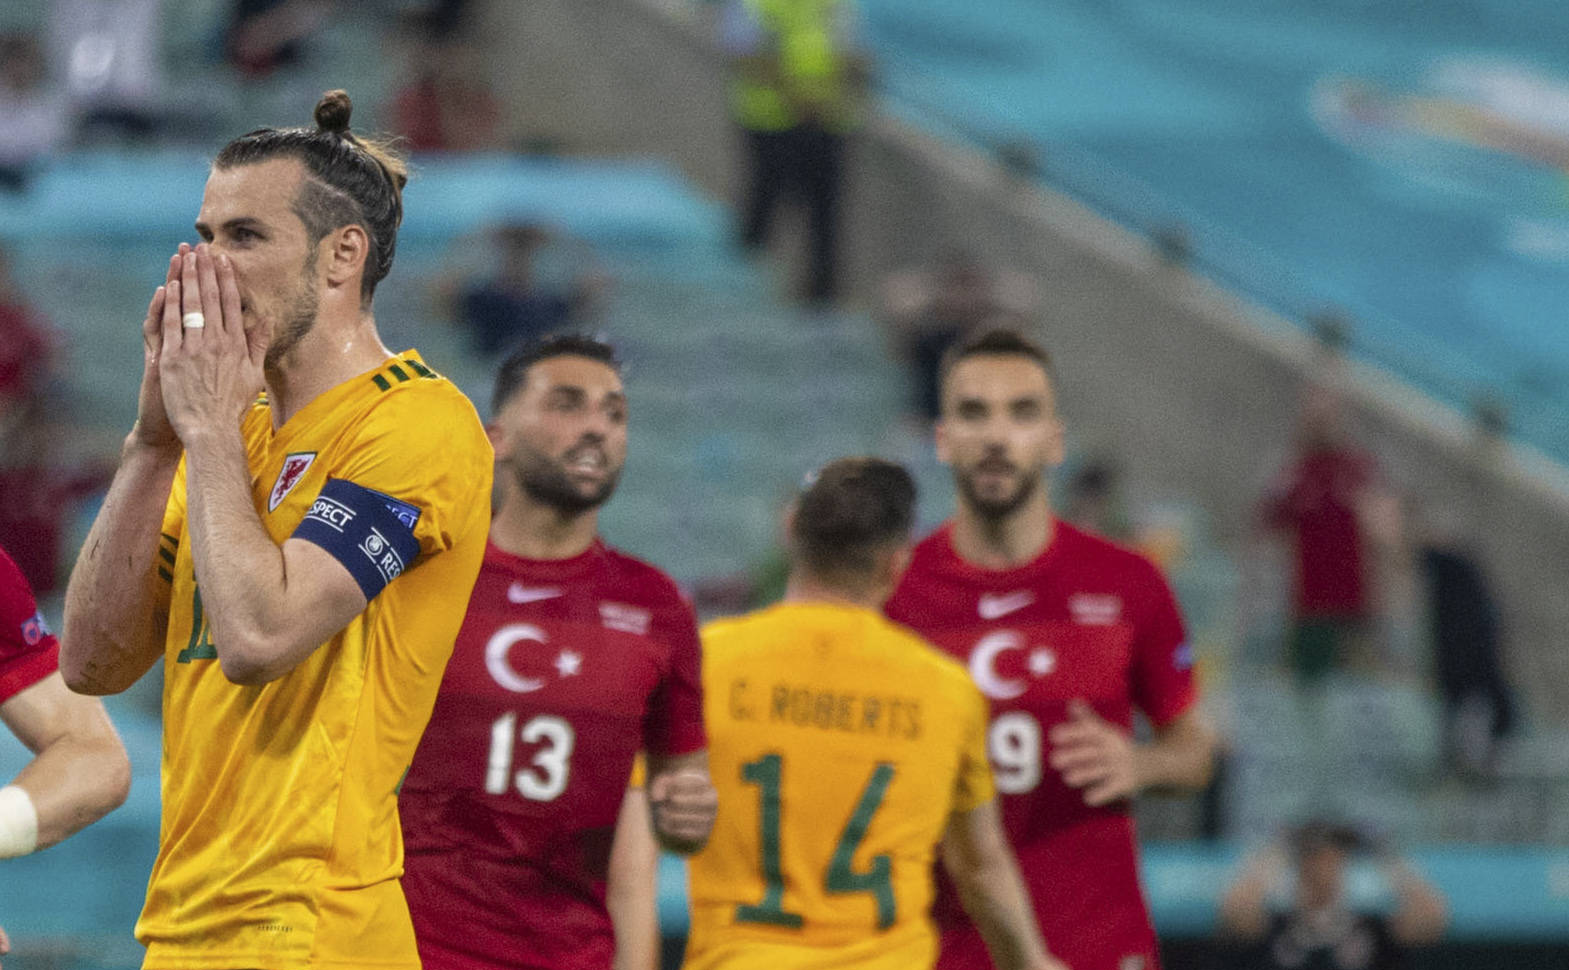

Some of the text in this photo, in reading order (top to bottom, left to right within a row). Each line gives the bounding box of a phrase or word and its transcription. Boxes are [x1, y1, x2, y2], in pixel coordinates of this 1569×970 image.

[308, 500, 353, 527] SPECT
[769, 683, 923, 741] ROBERTS
[987, 711, 1042, 795] 9
[485, 710, 575, 801] 13
[735, 753, 898, 931] 14
